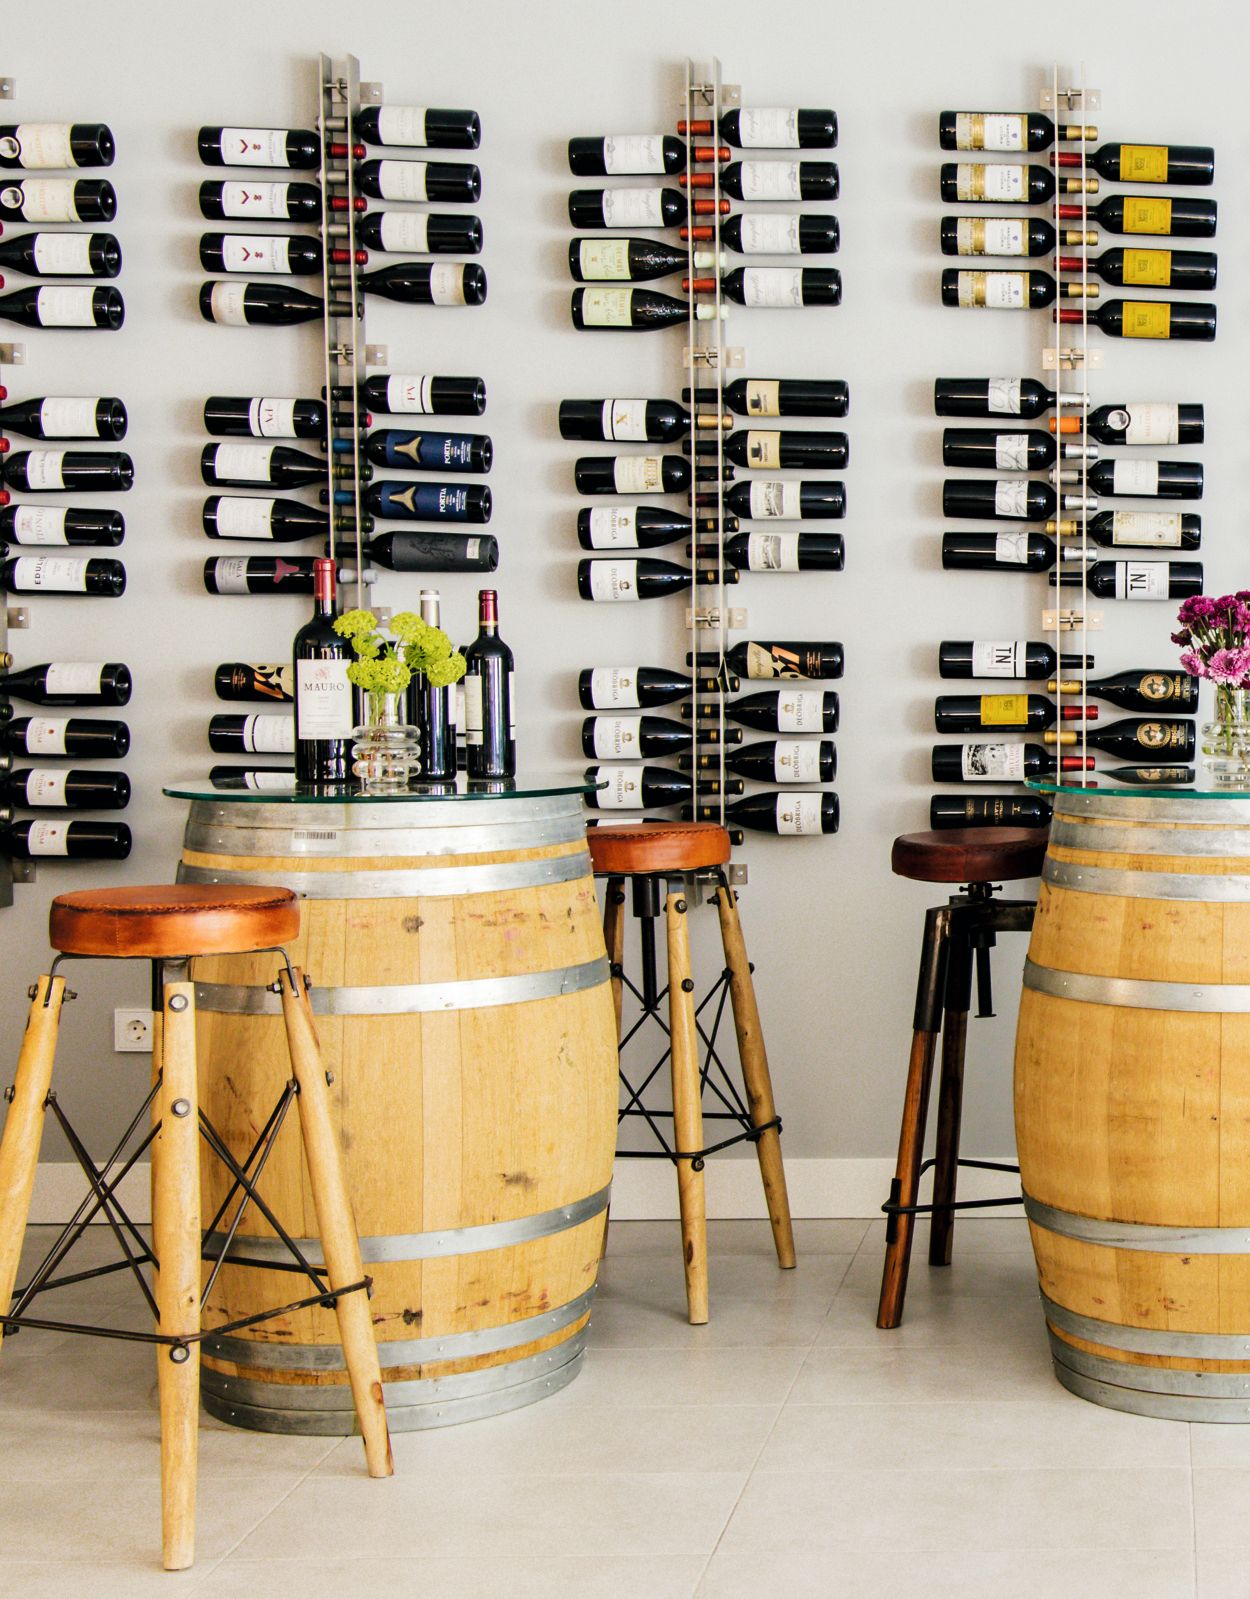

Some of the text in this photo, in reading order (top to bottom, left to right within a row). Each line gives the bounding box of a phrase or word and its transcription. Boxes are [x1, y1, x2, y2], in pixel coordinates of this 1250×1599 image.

[439, 488, 447, 512] PORTIA
[34, 556, 46, 585] EDULIS
[1130, 574, 1146, 591] TN
[996, 647, 1011, 663] TN
[304, 683, 344, 691] MAURO
